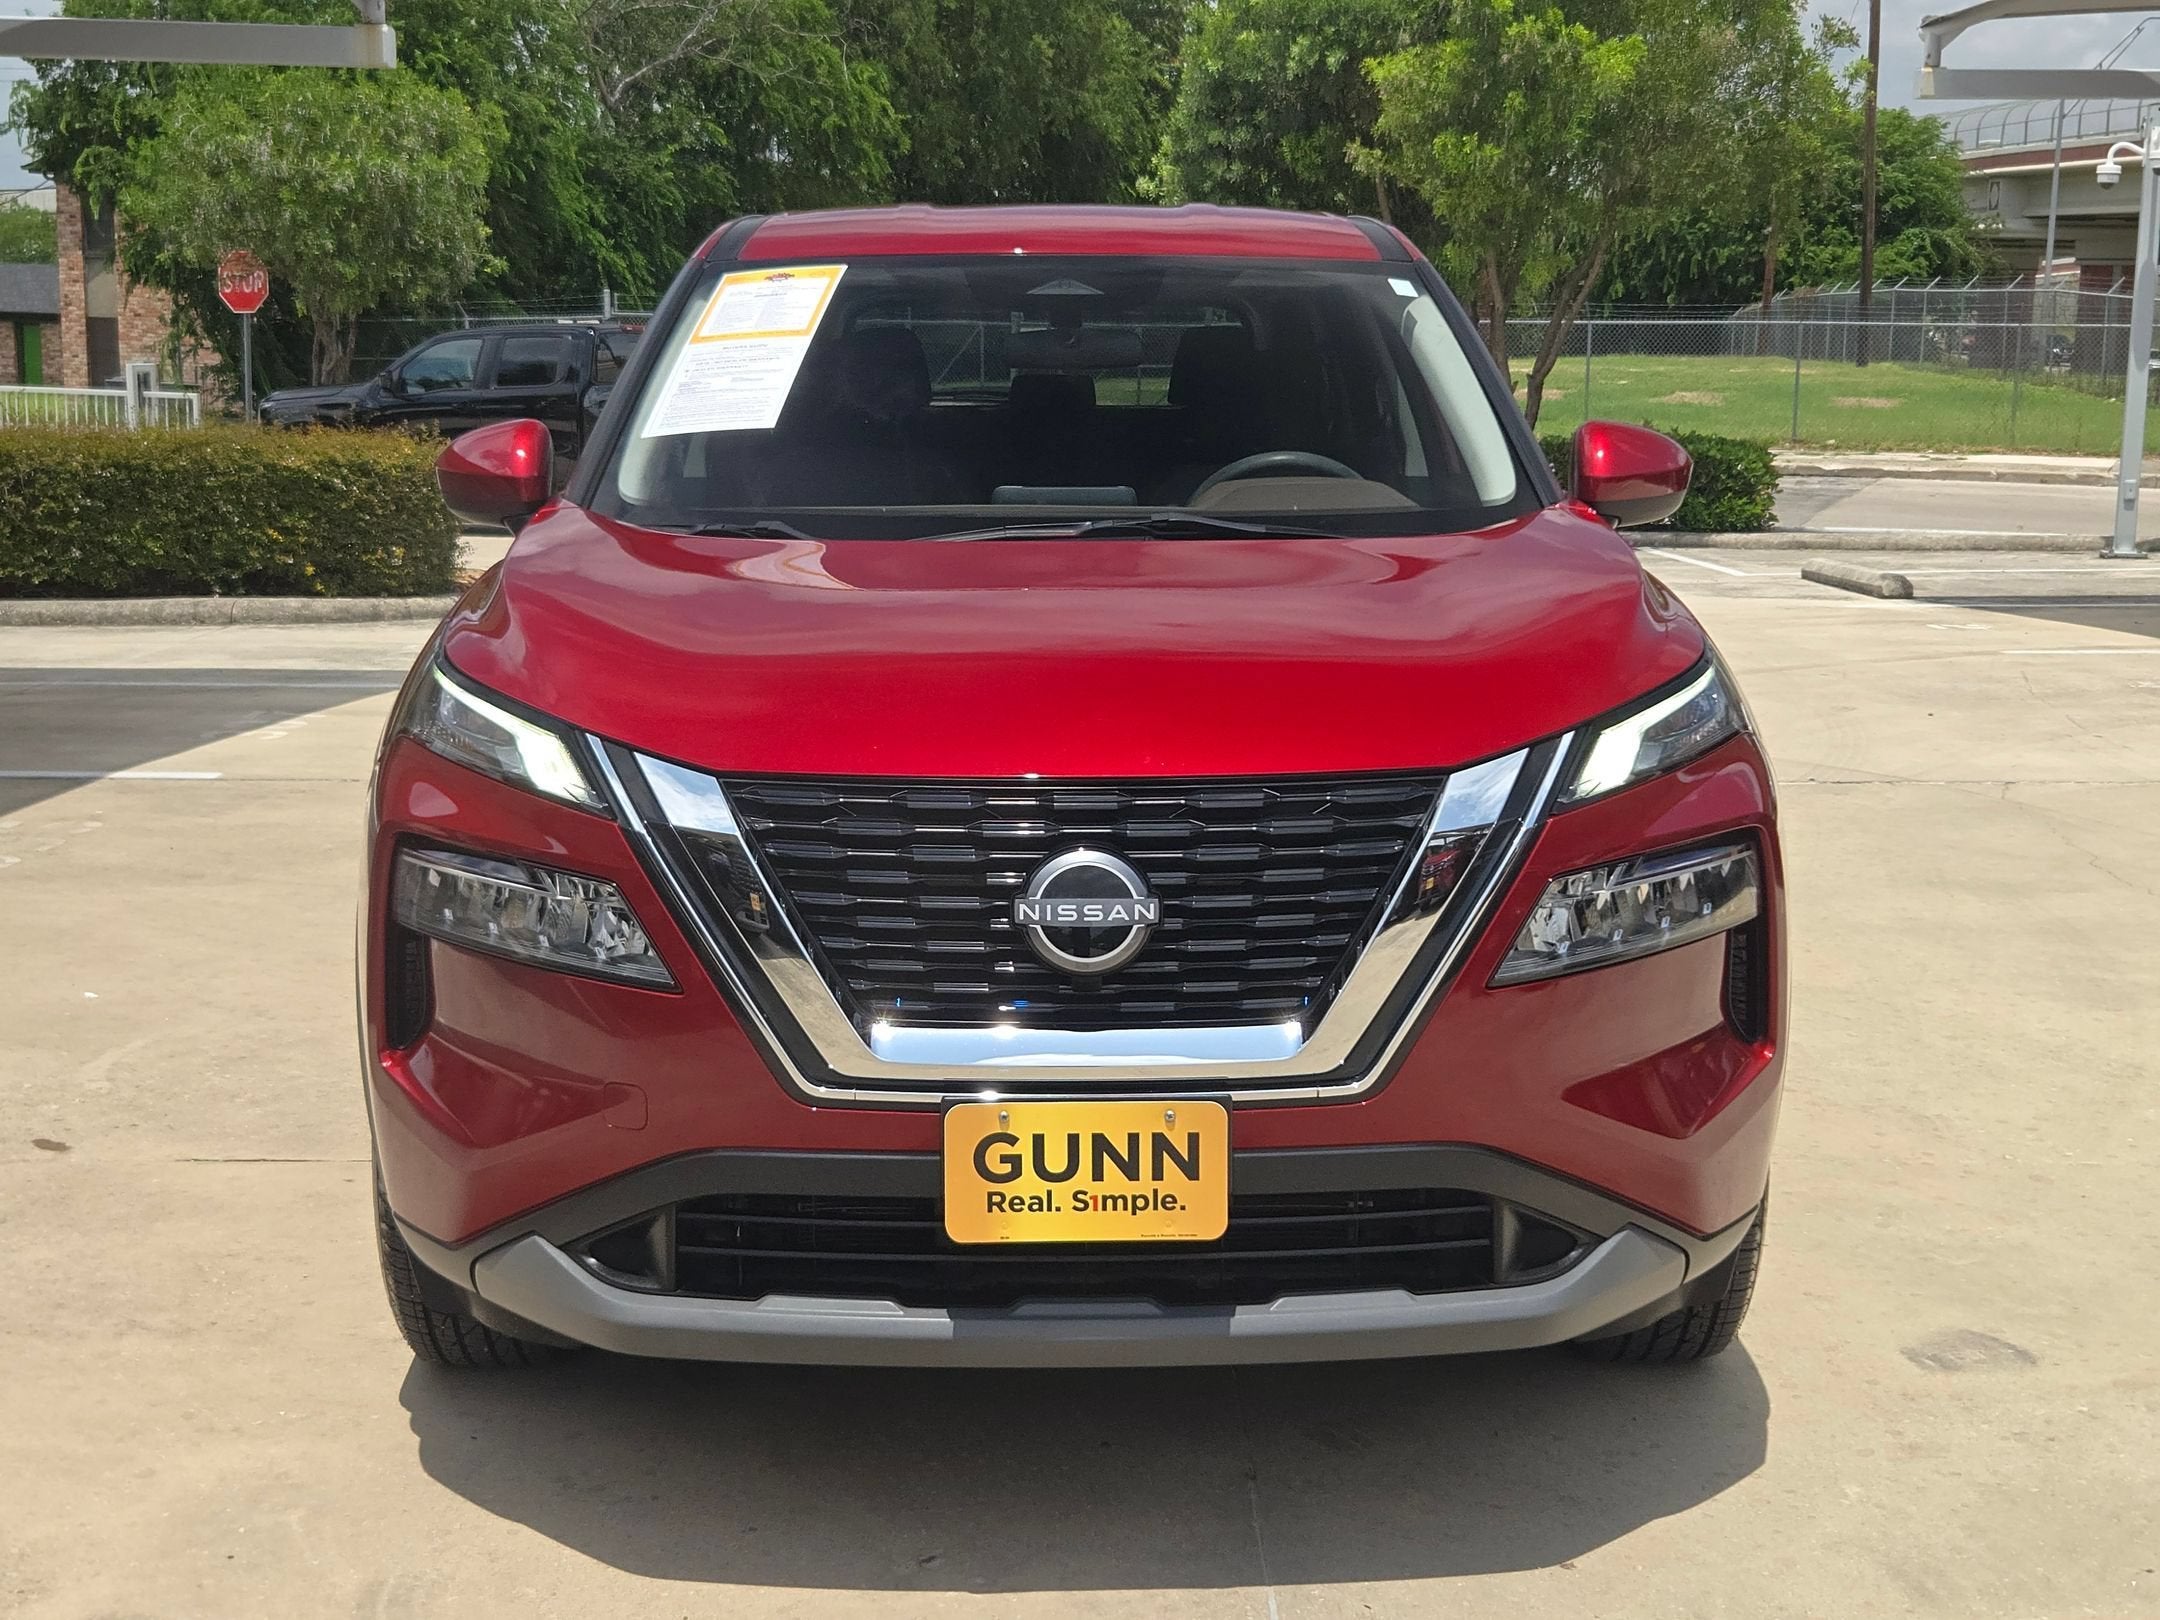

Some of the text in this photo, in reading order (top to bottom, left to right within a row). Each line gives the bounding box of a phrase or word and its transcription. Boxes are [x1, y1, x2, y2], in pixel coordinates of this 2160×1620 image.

[1019, 903, 1155, 921] NISSAN
[973, 1131, 1200, 1184] GUNN
[986, 1189, 1061, 1213] Real.
